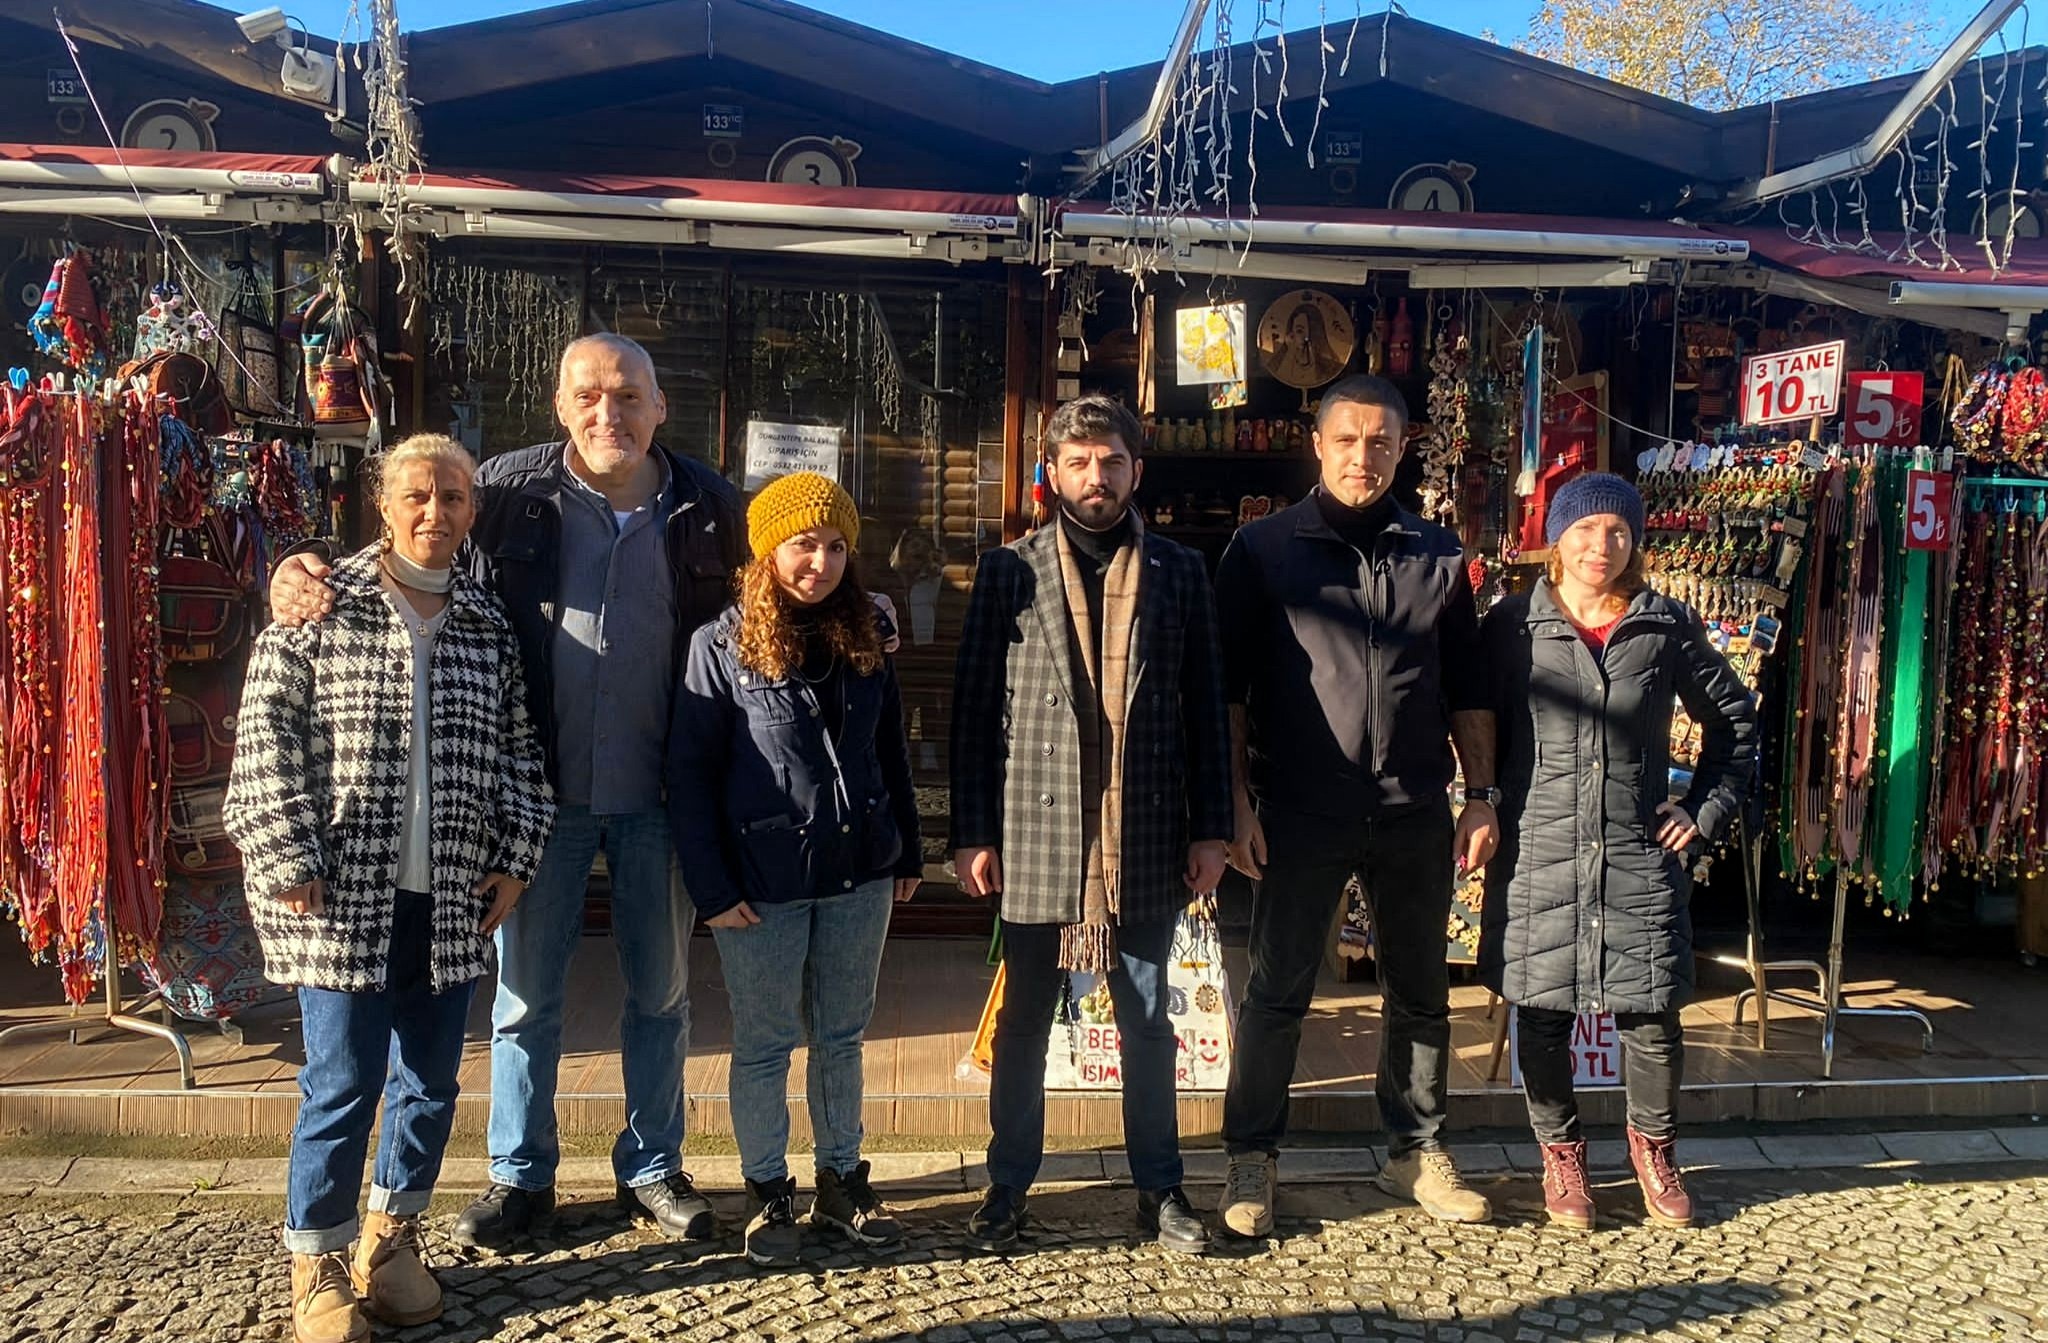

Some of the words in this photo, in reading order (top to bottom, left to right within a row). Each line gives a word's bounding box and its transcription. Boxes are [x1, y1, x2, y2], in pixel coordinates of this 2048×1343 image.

[160, 128, 177, 150] 2
[804, 163, 820, 186] 3
[1423, 190, 1442, 211] 4
[1756, 363, 1768, 379] 3
[1777, 350, 1835, 376] TANE
[1756, 375, 1805, 418] 10
[1808, 395, 1829, 411] TL
[1584, 1052, 1616, 1077] TL
